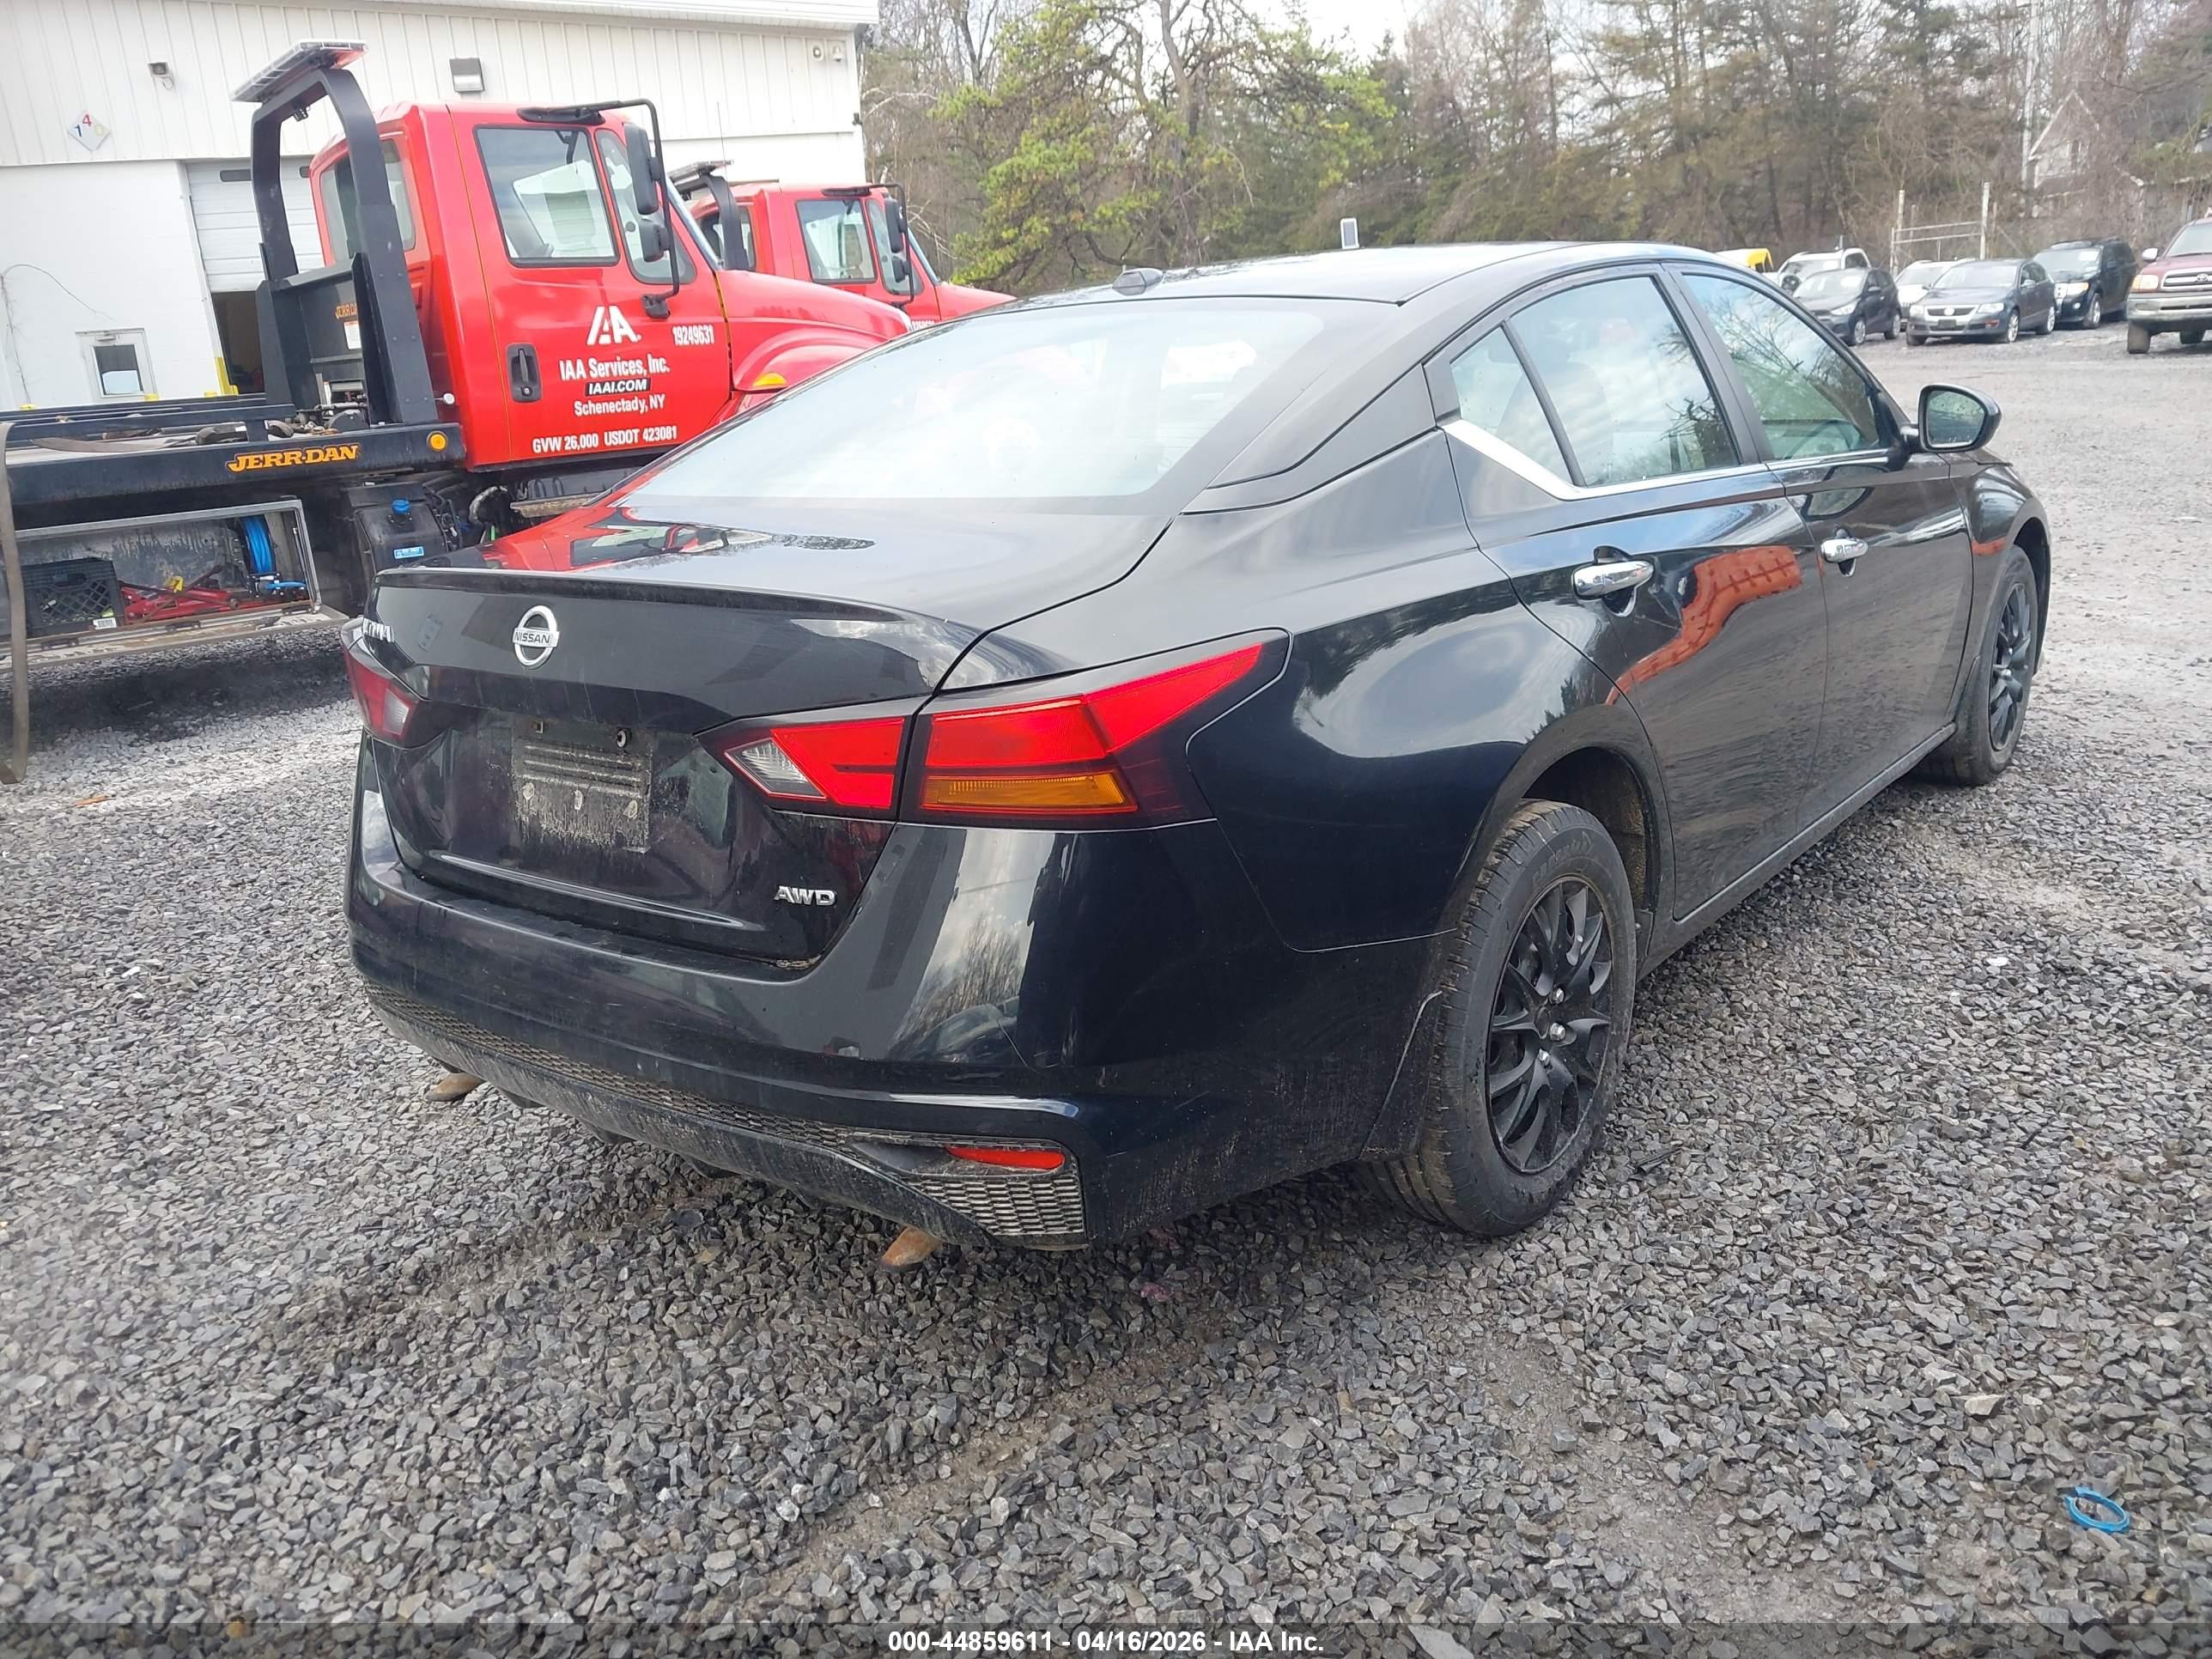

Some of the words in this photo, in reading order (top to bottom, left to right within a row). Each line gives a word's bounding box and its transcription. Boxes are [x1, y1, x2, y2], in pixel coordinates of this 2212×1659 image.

[82, 113, 92, 126] 4
[74, 124, 82, 137] 1
[672, 324, 715, 346] 19249631
[559, 359, 587, 381] IAA
[588, 355, 647, 379] Services,
[647, 353, 671, 374] Inc.
[588, 379, 647, 395] IAAI.COM
[574, 395, 648, 416] Schenectady,
[649, 393, 665, 410] NY
[532, 436, 562, 453] GVW
[563, 432, 599, 451] 26,000
[604, 428, 641, 447] USDOT
[642, 425, 678, 443] 423081
[514, 631, 551, 645] NISSAN
[774, 885, 836, 906] AWD
